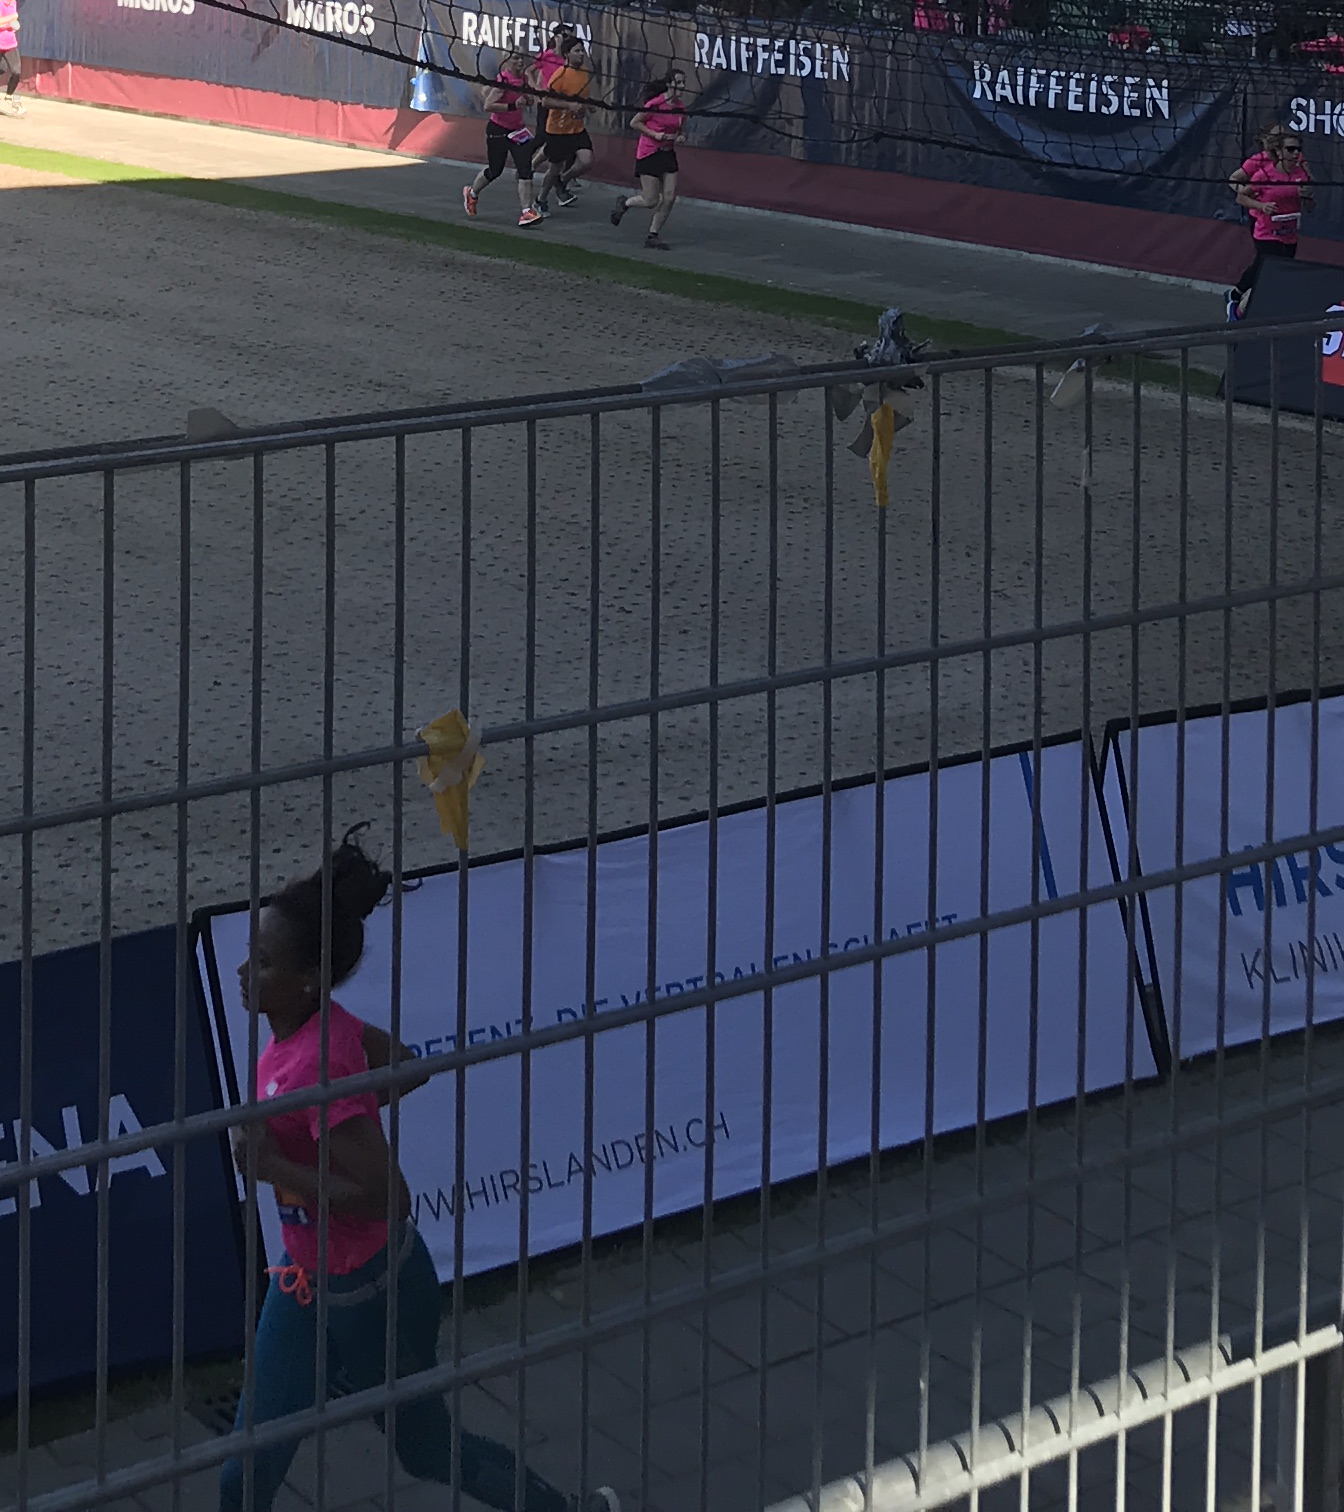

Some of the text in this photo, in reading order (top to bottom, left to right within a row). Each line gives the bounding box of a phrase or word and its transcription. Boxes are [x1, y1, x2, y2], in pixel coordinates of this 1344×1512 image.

[462, 11, 593, 57] RAIFFEISN
[694, 32, 851, 82] RAIFFEISEN
[972, 60, 1170, 120] RAIFFEISEN
[407, 1111, 732, 1228] WW.HIRSLANDEN.CH
